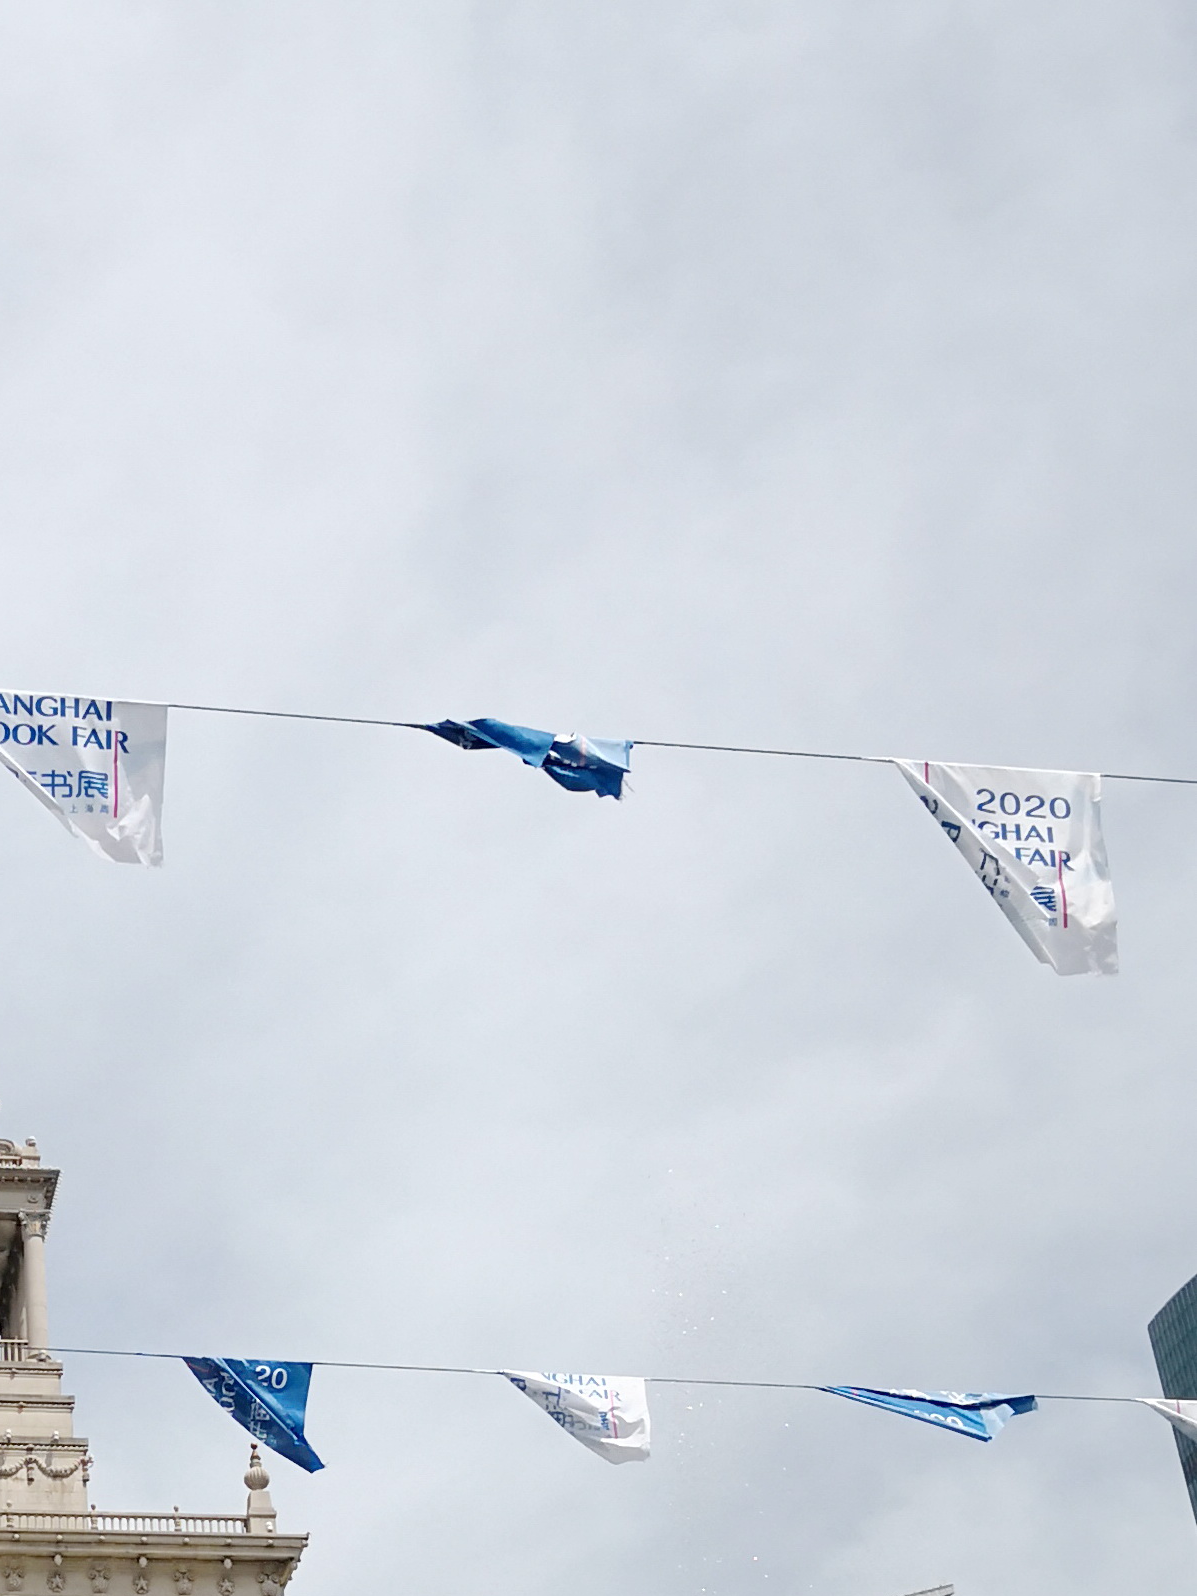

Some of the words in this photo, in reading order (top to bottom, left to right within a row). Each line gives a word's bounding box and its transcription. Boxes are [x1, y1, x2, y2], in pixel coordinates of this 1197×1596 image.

[71, 726, 130, 754] FAIR
[975, 788, 1072, 820] 2020
[972, 819, 1055, 844] GHAI
[1014, 848, 1076, 872] FAIR
